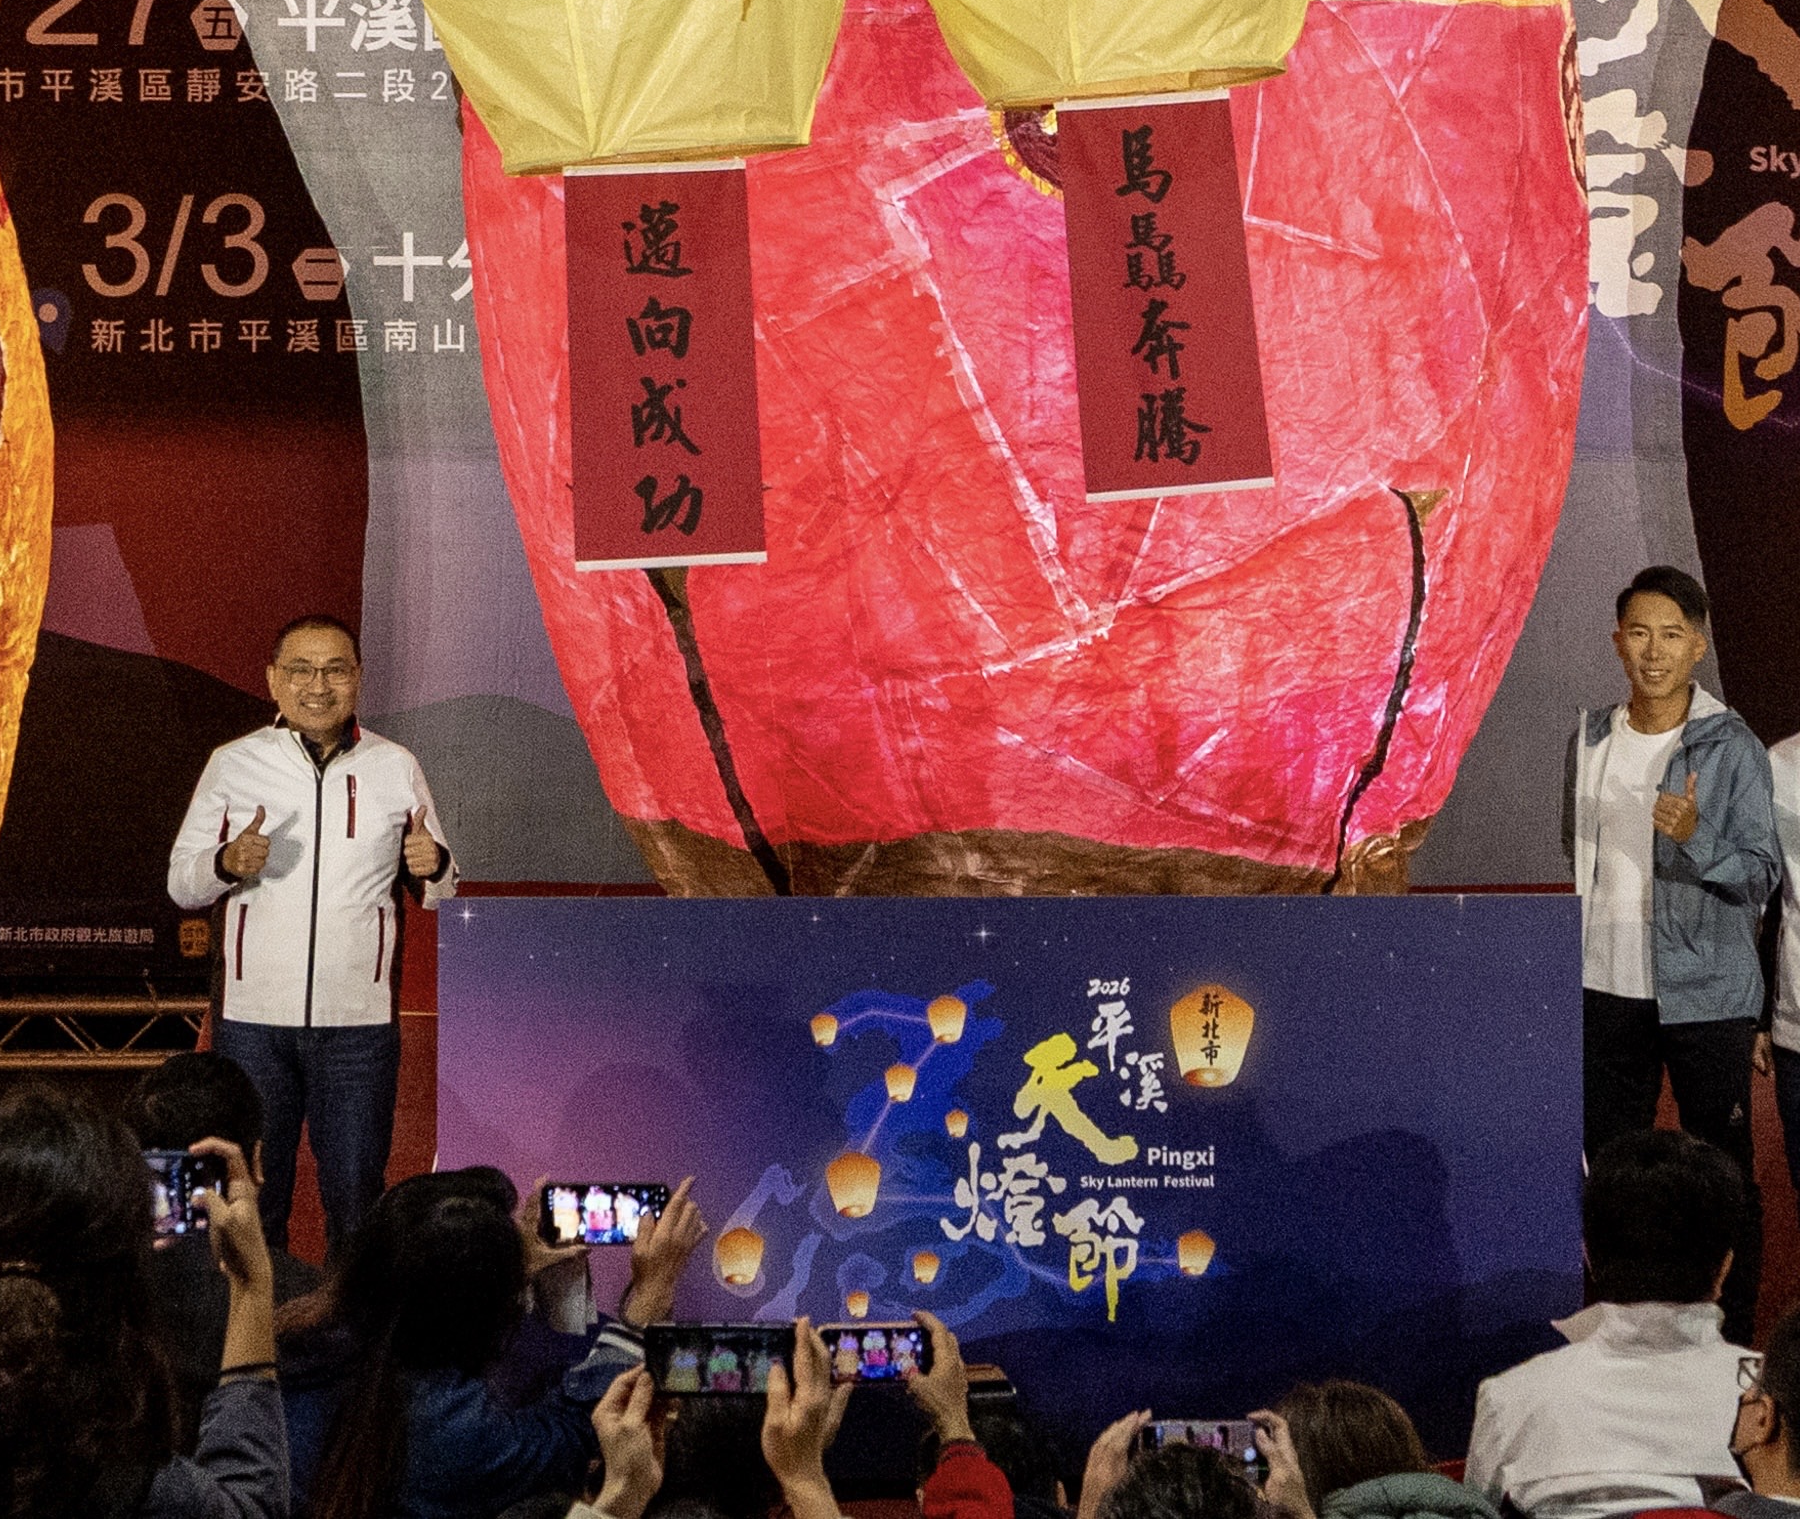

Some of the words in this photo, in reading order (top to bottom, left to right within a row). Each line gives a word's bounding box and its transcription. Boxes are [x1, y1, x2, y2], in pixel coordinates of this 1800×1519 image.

[200, 6, 238, 41] 五
[81, 193, 270, 299] 3/3
[620, 201, 706, 538] 邁向成功
[1088, 978, 1130, 996] 2026
[1088, 1001, 1169, 1113] 平溪
[1199, 993, 1224, 1066] 新北市
[940, 1032, 1145, 1324] 天燈節
[1080, 1175, 1105, 1191] Sky
[1107, 1174, 1158, 1189] Lantern
[1163, 1174, 1215, 1189] Festival
[1147, 1146, 1216, 1171] Pingxi
